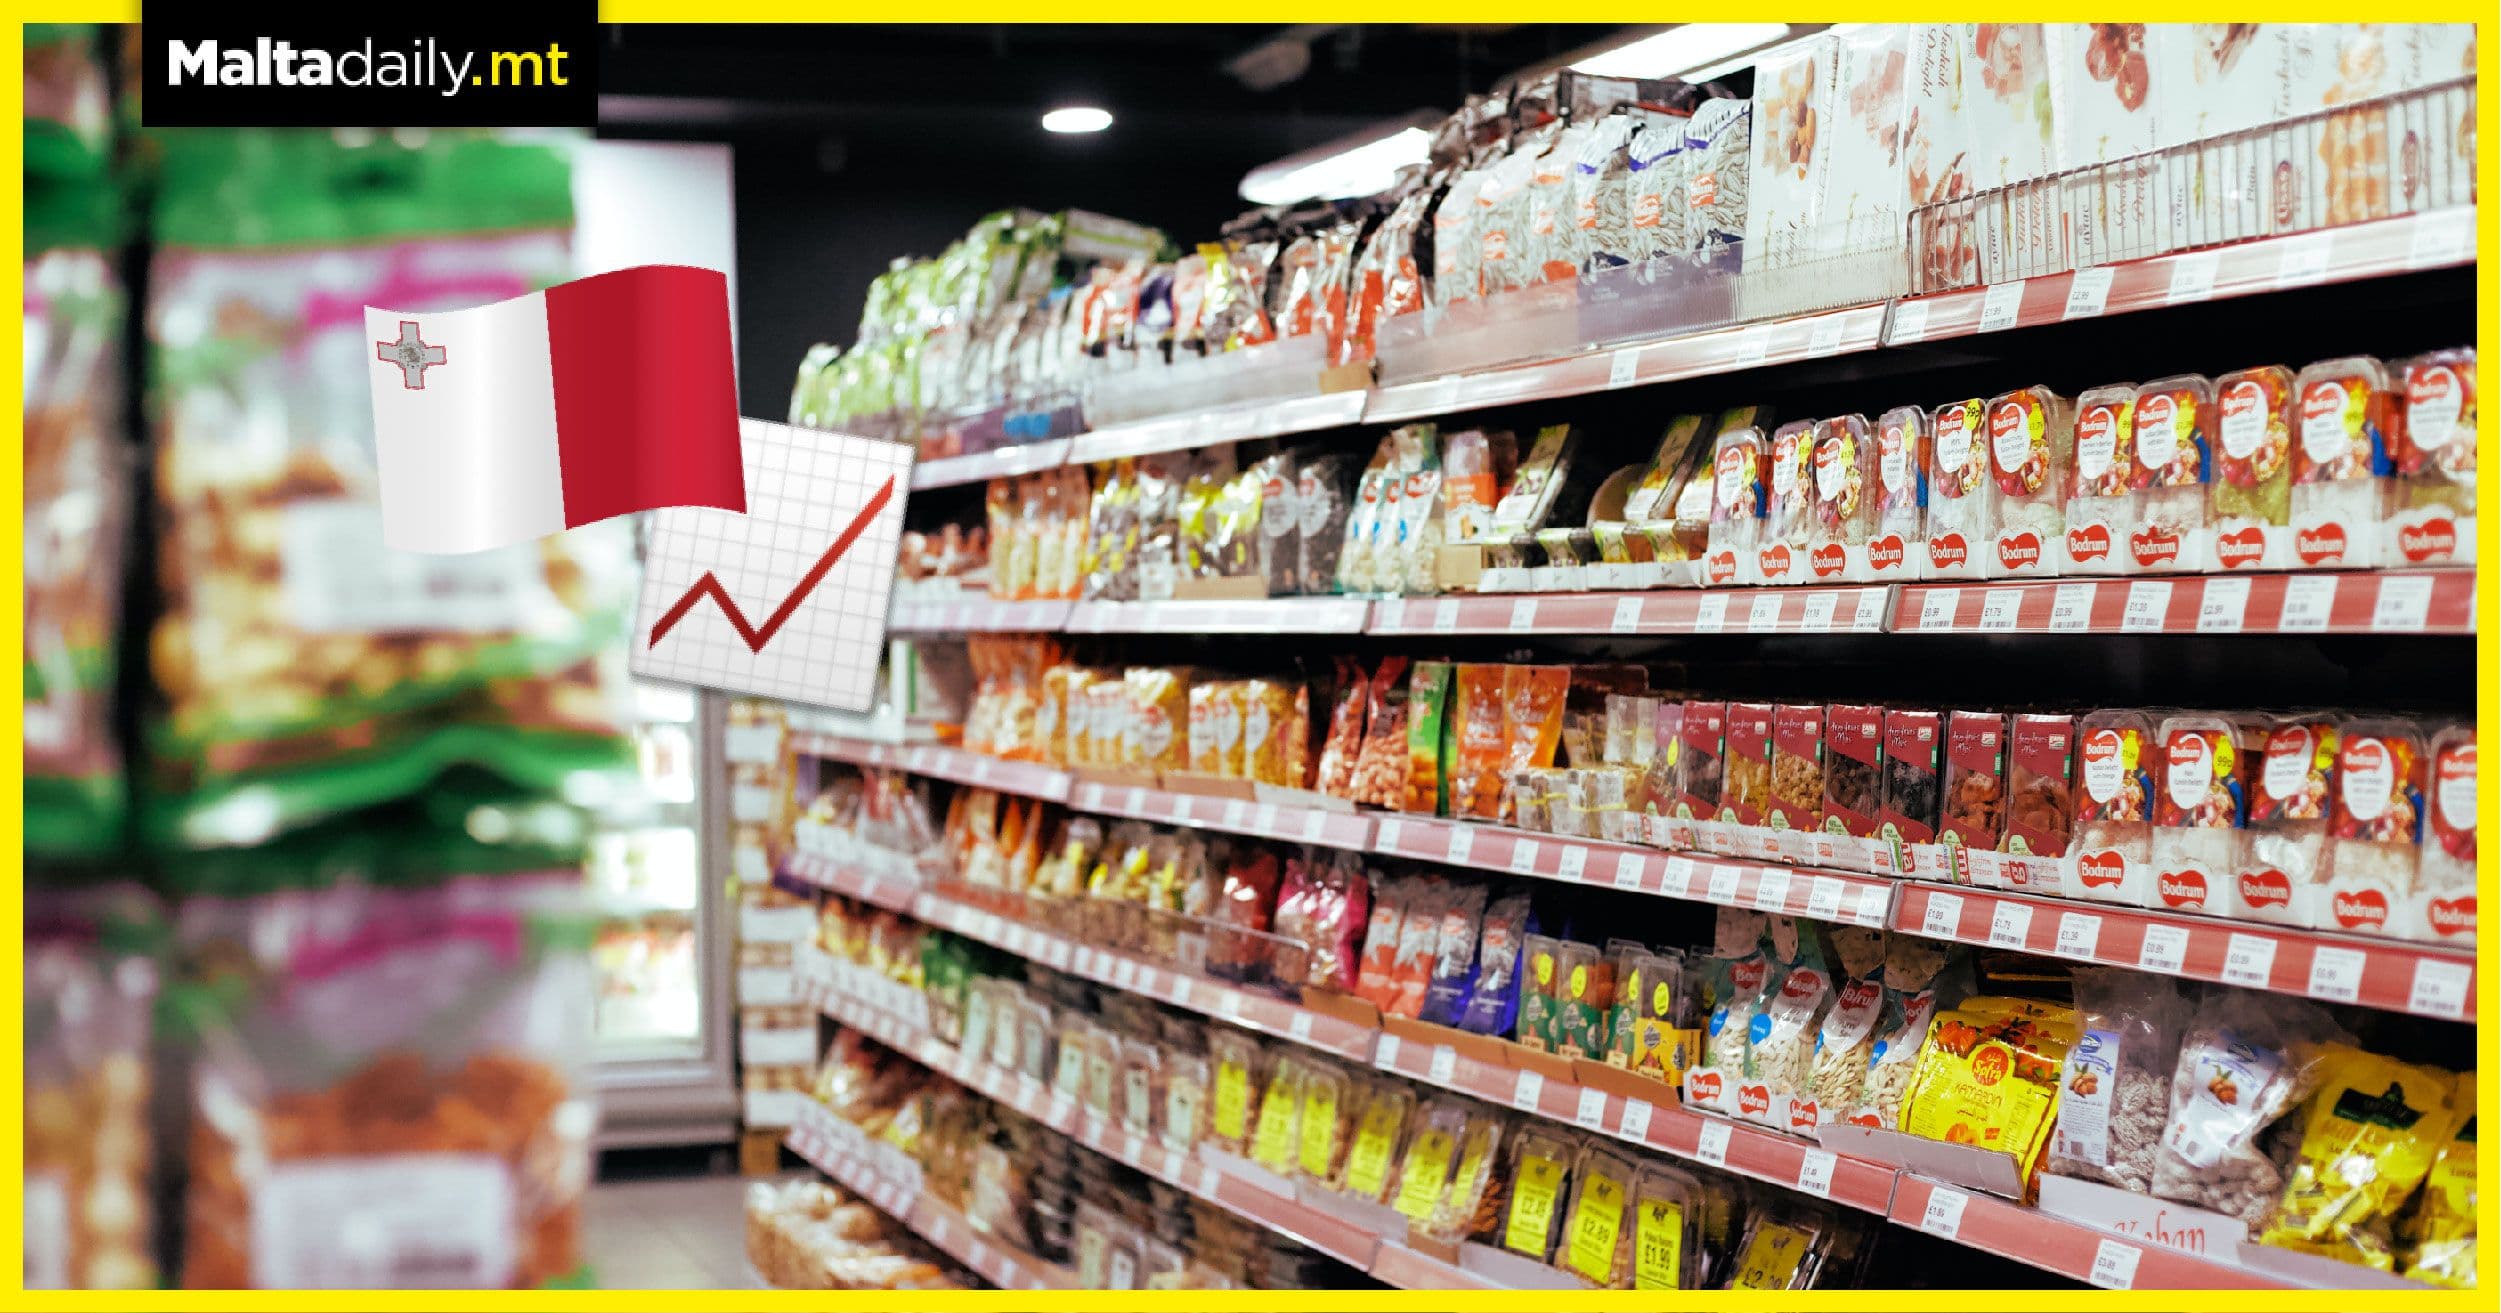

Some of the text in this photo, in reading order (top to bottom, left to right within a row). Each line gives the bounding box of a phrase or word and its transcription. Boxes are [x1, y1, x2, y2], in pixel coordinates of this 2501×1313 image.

[1966, 407, 1980, 420] 99p
[1993, 415, 2019, 431] Bodrum
[1931, 545, 1965, 560] Bodrum
[2001, 545, 2038, 560] Bodrum
[2069, 536, 2108, 553] Bodrum
[2134, 539, 2177, 556] Bodrum
[2219, 540, 2262, 557] Bodrum
[1761, 556, 1788, 569] Bodrum
[1813, 555, 1843, 569] Bodrum
[1871, 547, 1901, 562] Bodrum
[1710, 561, 1735, 575] Bodrum
[2086, 743, 2116, 755] Bodrum
[2081, 862, 2122, 879] Bodrum
[2162, 880, 2205, 898] Bodrum
[2243, 881, 2287, 899] Bodrum
[2338, 899, 2384, 919] Bodrum
[1974, 1059, 2002, 1081] Sofra
